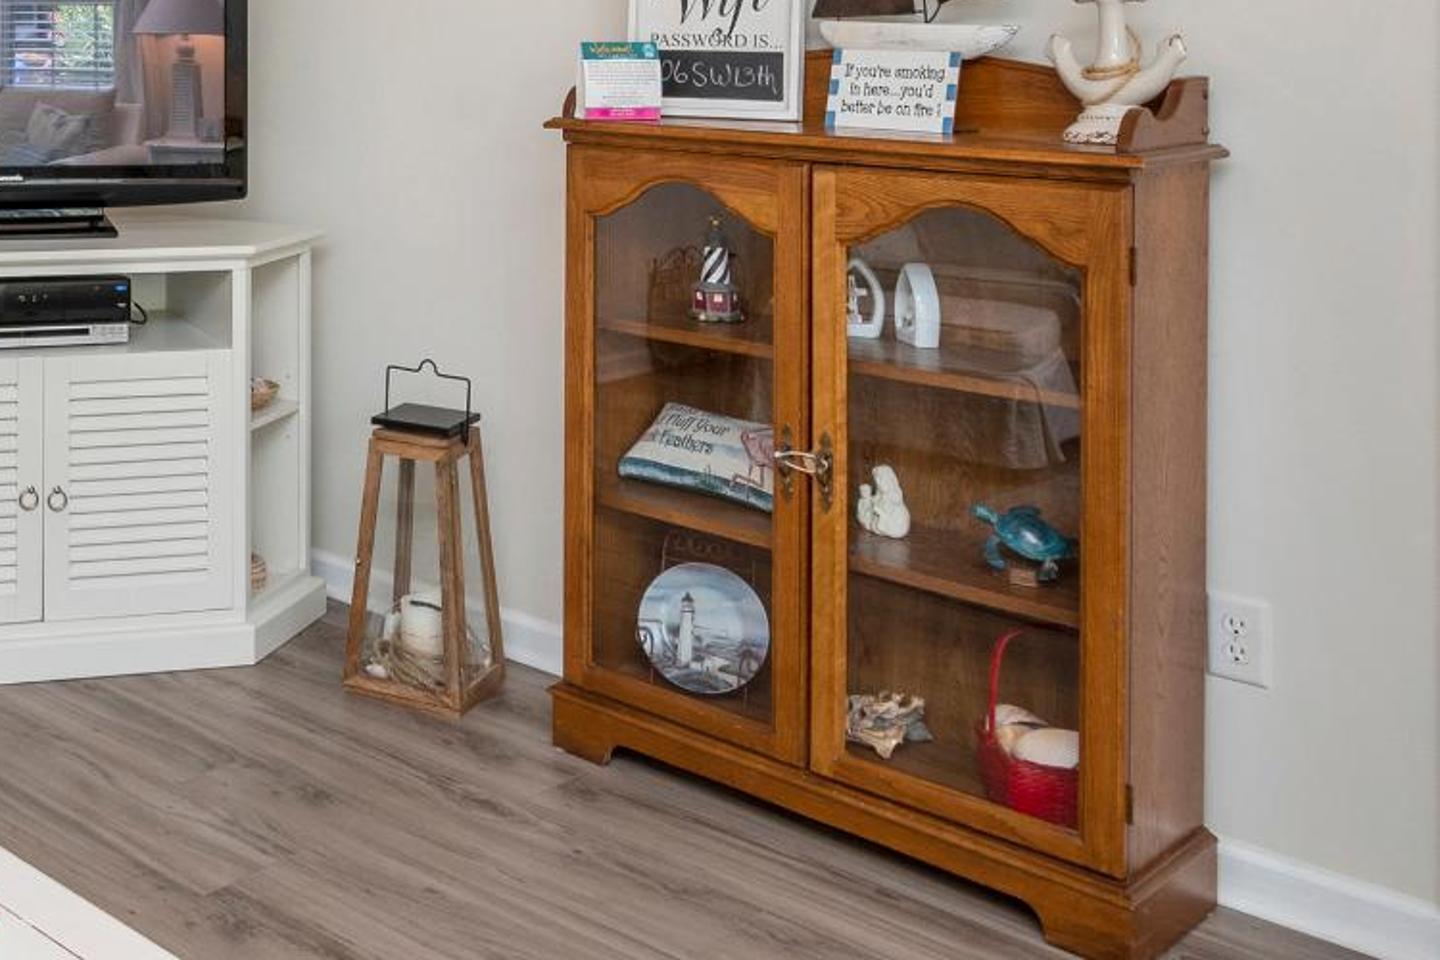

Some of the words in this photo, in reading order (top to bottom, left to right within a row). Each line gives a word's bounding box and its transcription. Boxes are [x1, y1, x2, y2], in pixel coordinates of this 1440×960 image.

[650, 33, 748, 48] PASSWORD
[753, 33, 783, 49] IS...
[855, 65, 892, 80] you're
[894, 65, 946, 83] smoking
[840, 99, 875, 115] better
[877, 100, 892, 116] be
[895, 103, 911, 117] on
